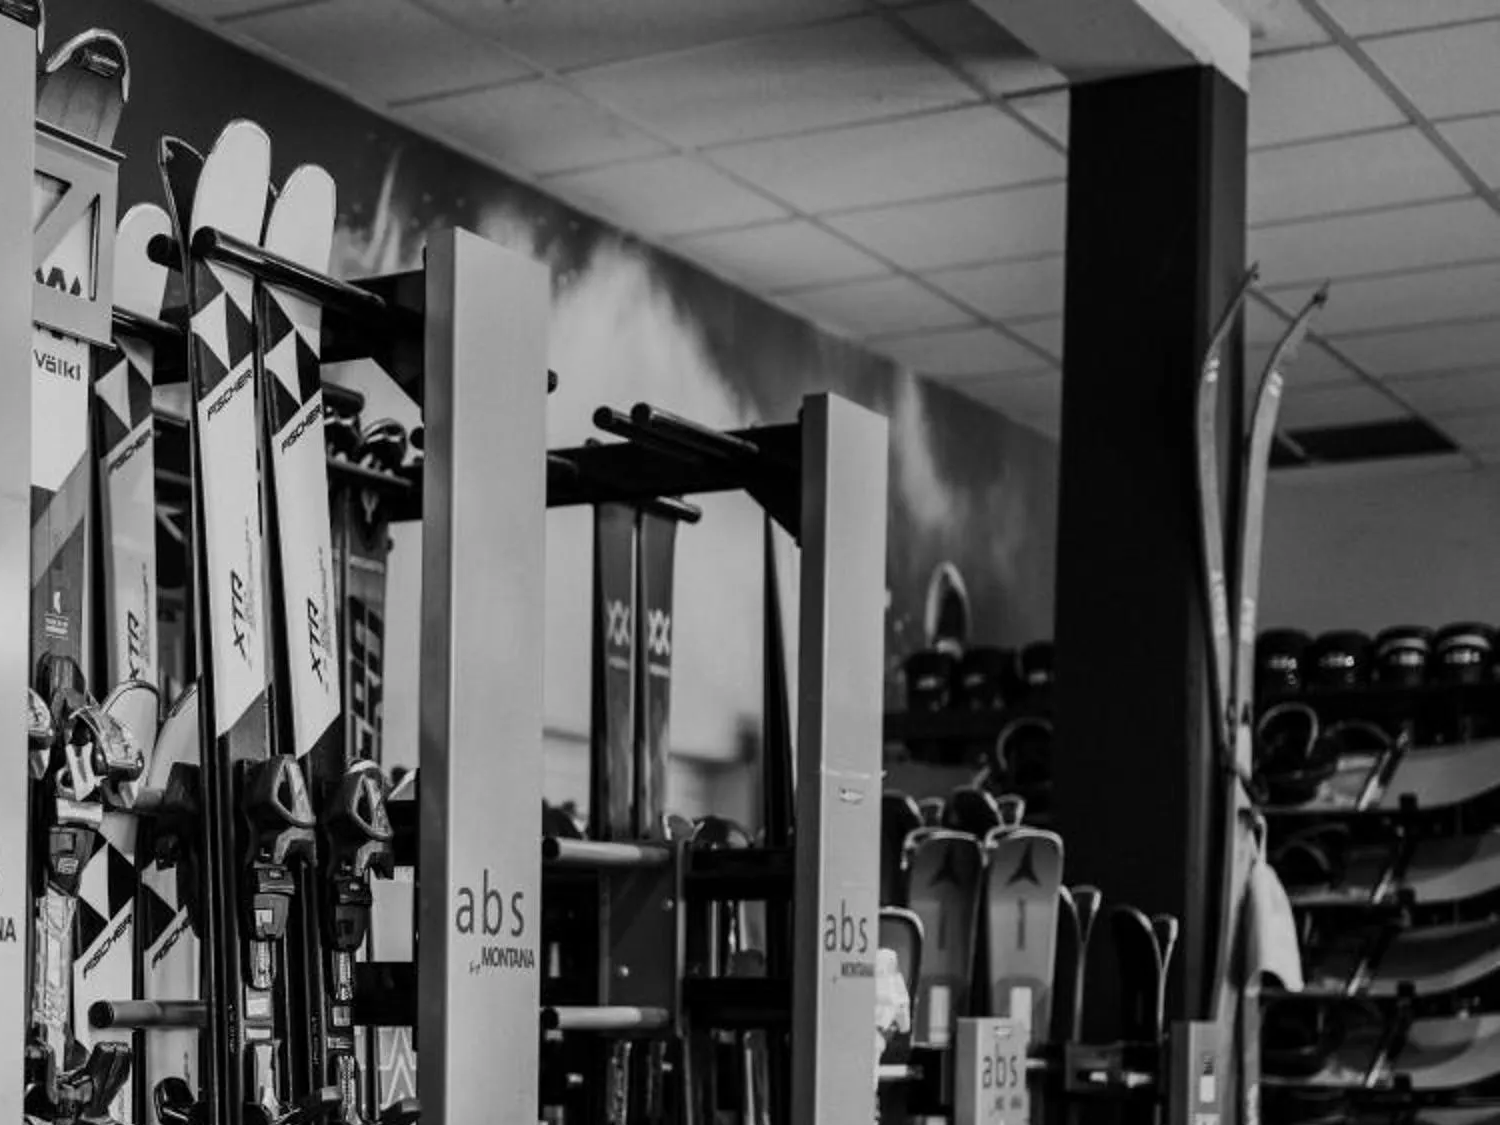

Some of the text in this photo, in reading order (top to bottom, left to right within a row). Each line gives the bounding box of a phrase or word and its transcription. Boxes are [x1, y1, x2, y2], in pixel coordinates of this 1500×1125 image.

[34, 349, 81, 381] Völkl
[456, 869, 525, 937] abs
[824, 898, 868, 954] abs
[481, 946, 535, 969] MONTANA
[982, 1042, 1018, 1089] abs
